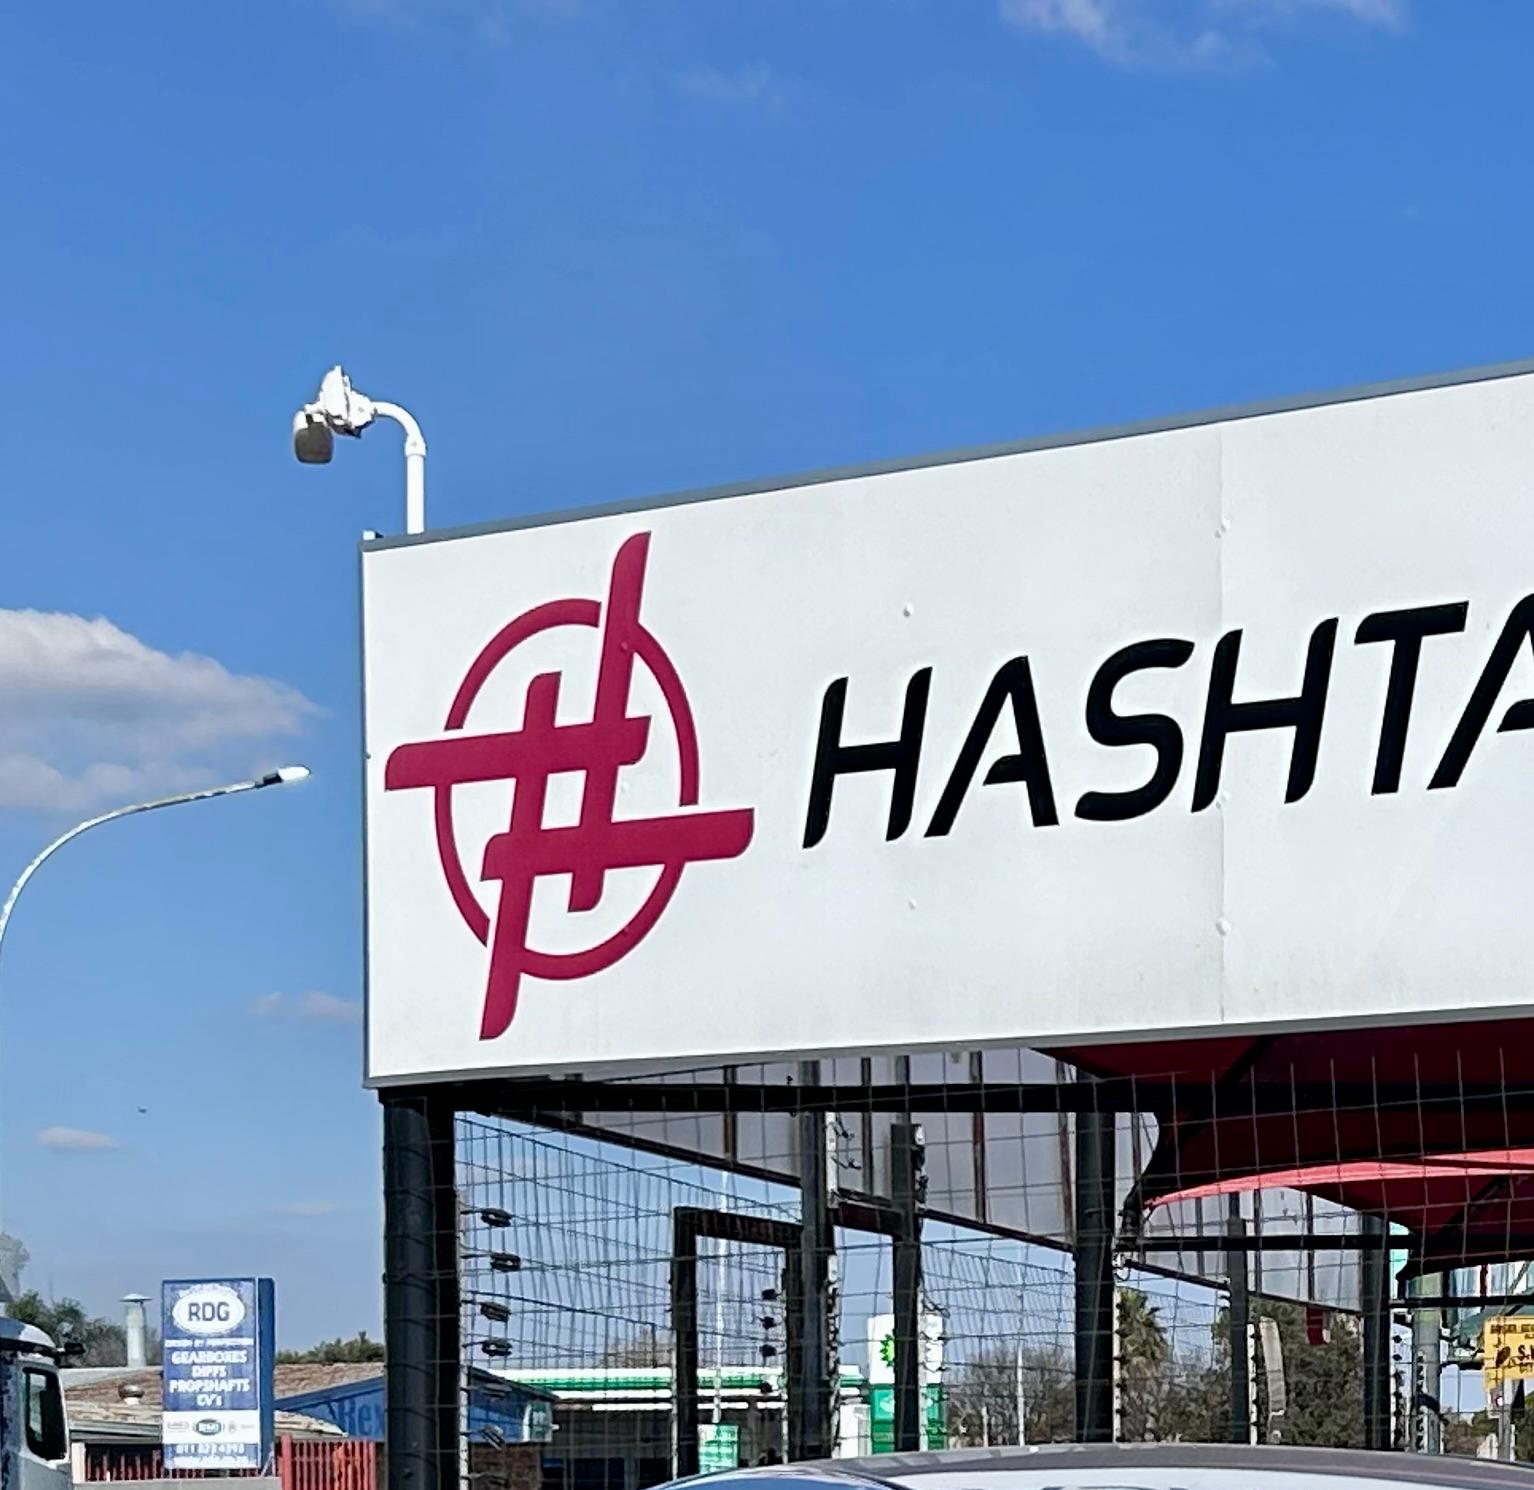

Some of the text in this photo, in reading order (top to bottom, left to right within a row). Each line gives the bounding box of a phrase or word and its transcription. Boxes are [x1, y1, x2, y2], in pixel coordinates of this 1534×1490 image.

[188, 1302, 230, 1321] RDG
[171, 1351, 247, 1365] GEARBOXES
[192, 1365, 227, 1378] DIFFS
[169, 1378, 249, 1393] PROPSHAFTS
